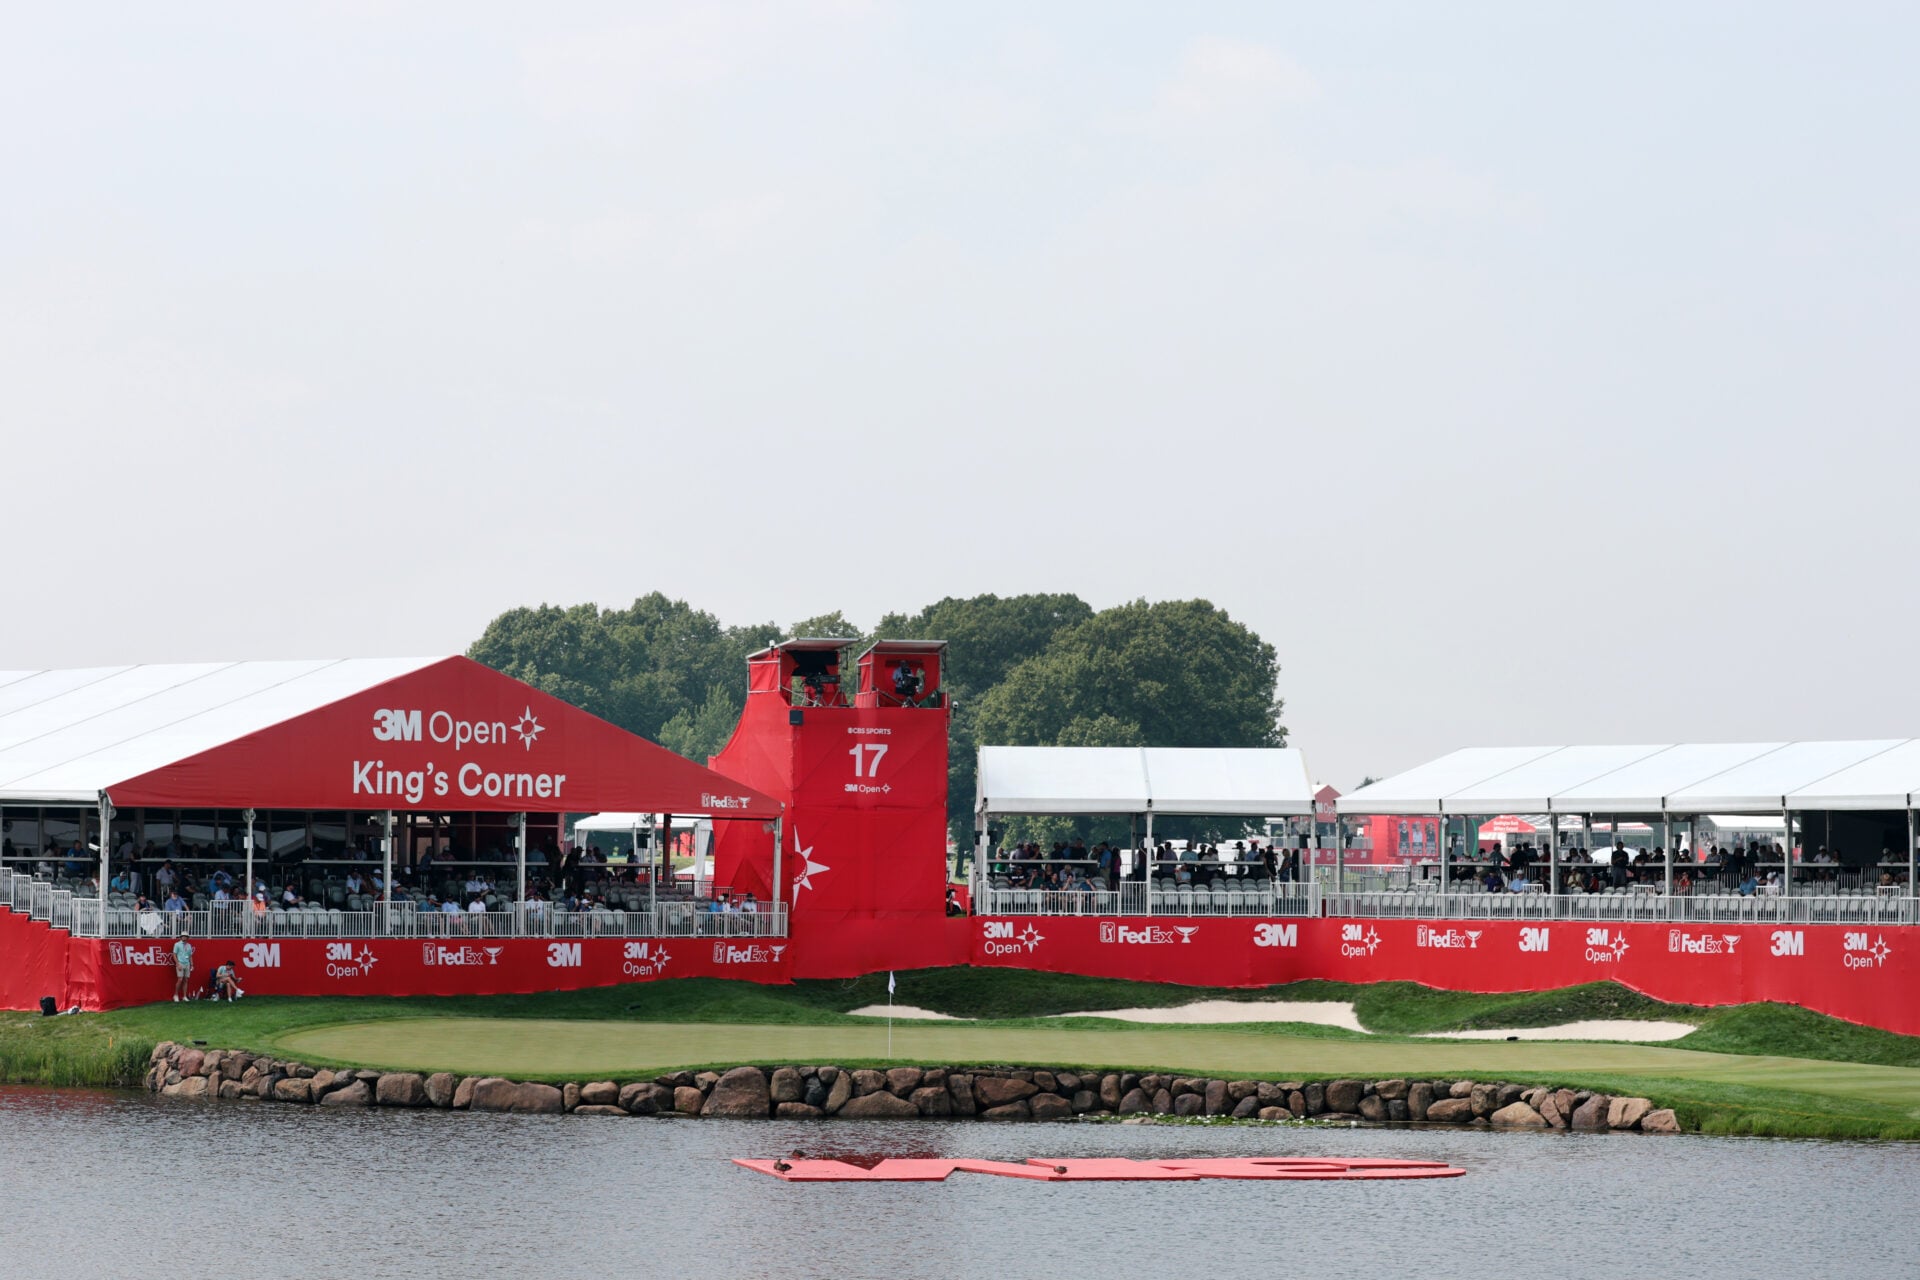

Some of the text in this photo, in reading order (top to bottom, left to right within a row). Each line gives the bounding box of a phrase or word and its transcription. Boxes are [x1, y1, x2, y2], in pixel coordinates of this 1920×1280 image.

[372, 708, 507, 751] 3M Open
[853, 727, 892, 736] CBS SPORTS
[848, 743, 888, 778] 17
[353, 760, 566, 804] King's Corner
[844, 783, 881, 794] 3M Open
[711, 796, 739, 809] FedEx
[983, 921, 1014, 939] 3M
[1118, 925, 1173, 945] FedEx
[1253, 923, 1298, 947] 3M
[1341, 923, 1362, 941] 3M
[1427, 928, 1465, 948] FedEx
[1518, 927, 1550, 952] 3M
[1585, 927, 1608, 946] 3M
[623, 941, 648, 959] 3M
[983, 940, 1021, 958] Open
[1341, 943, 1366, 959] Open
[1681, 933, 1722, 954] FedEx
[1770, 930, 1804, 957] 3M
[1843, 932, 1868, 951] 3M
[124, 945, 173, 966] FedEx
[242, 942, 281, 968] 3M
[325, 942, 352, 961] 3M
[437, 946, 484, 966] FedEx
[546, 942, 582, 967] 3M
[726, 944, 768, 964] FedEx
[1585, 946, 1612, 964] Open
[1843, 951, 1873, 970] Open
[326, 962, 359, 980] Open
[623, 960, 653, 977] Open
